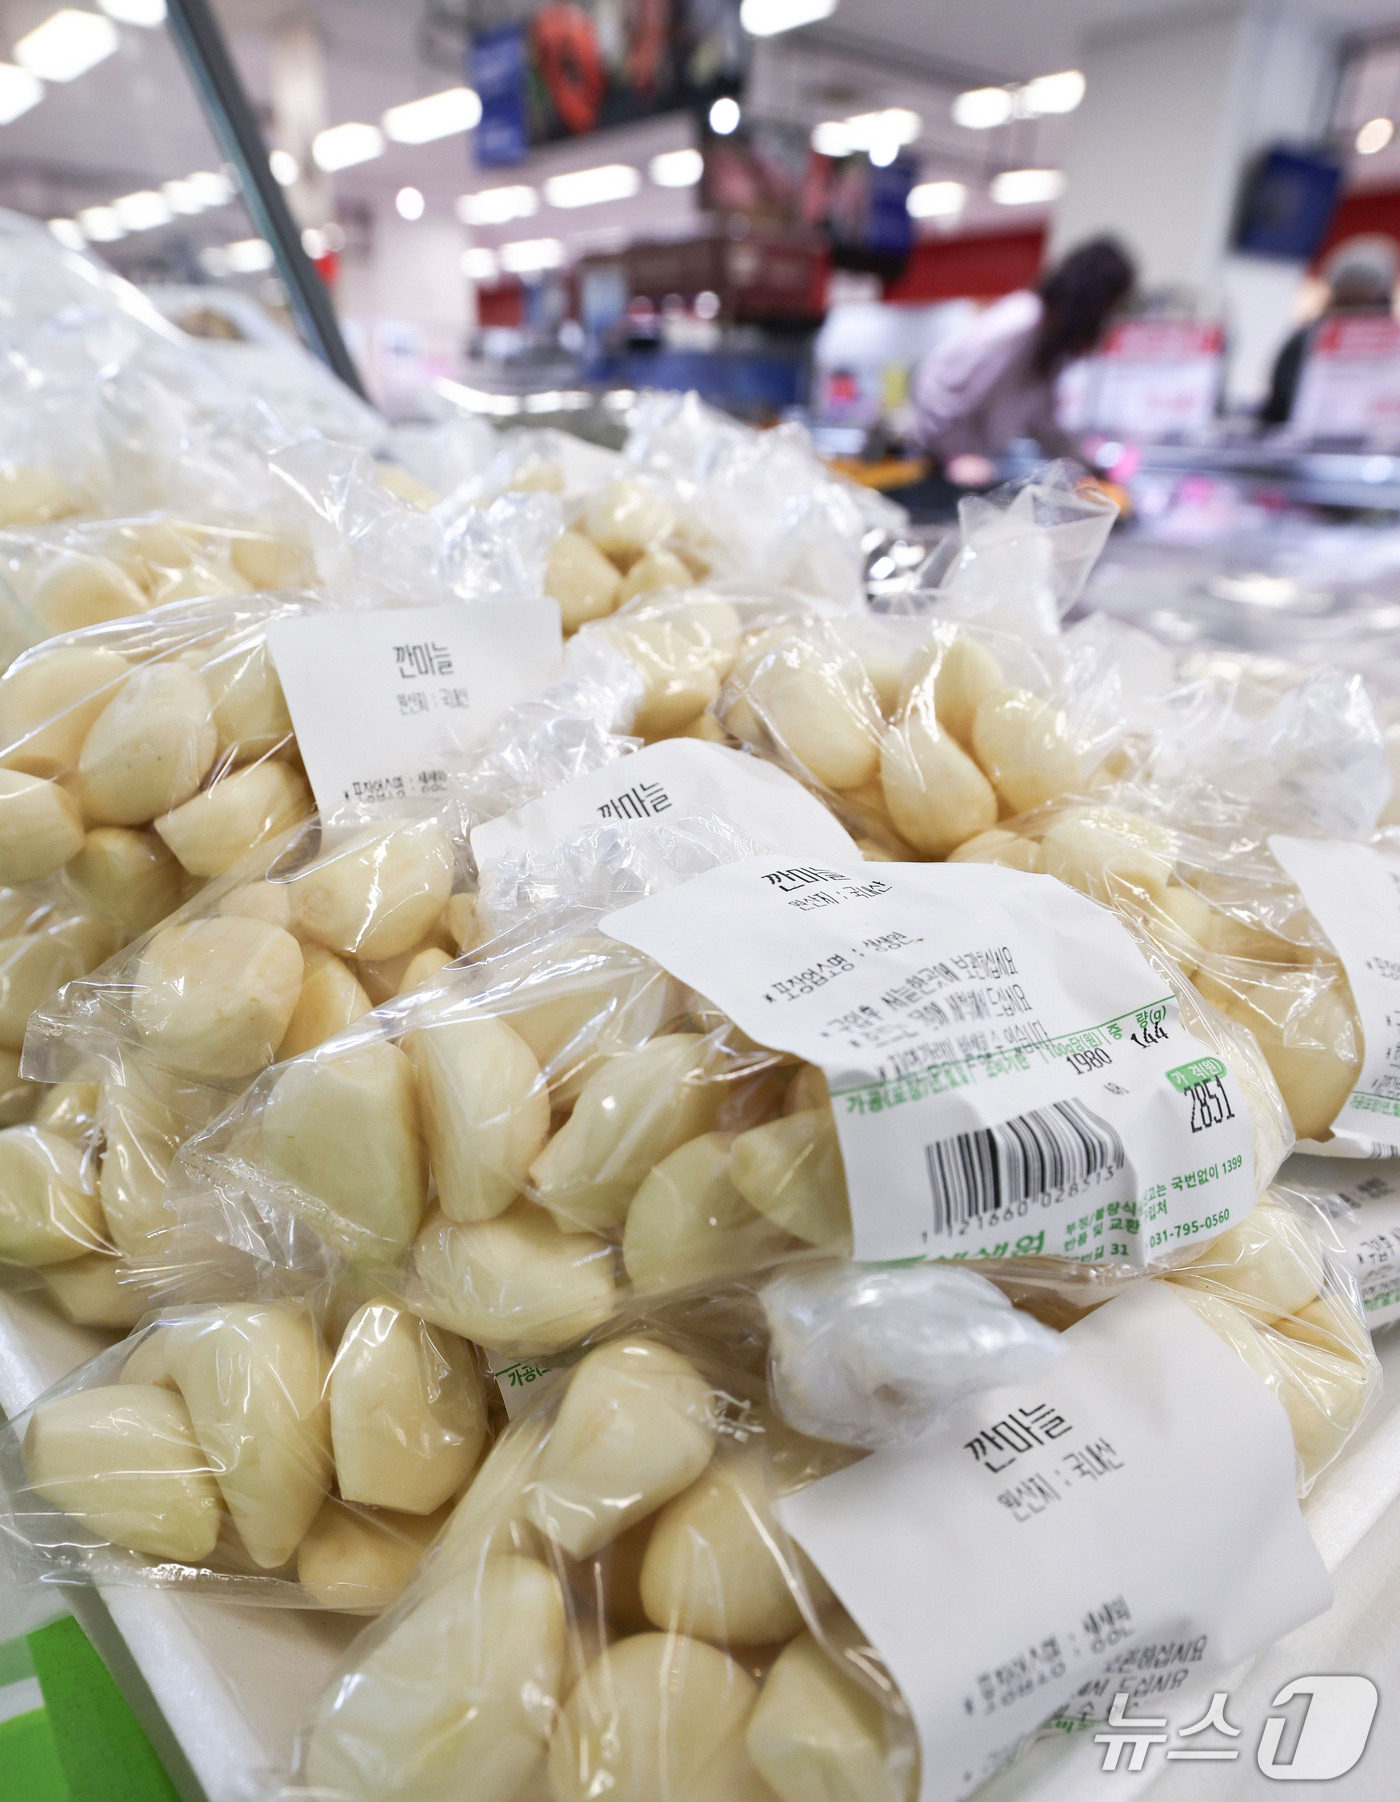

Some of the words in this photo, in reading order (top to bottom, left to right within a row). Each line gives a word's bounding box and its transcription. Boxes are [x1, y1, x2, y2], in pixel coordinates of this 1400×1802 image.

[393, 642, 454, 678] 깐마늘
[761, 866, 851, 892] 깐마늘
[788, 890, 840, 911] 원산지
[844, 880, 893, 899] 국내산
[771, 954, 855, 1002] 포장업소명
[881, 961, 962, 1012] 서늘한곳에
[1046, 1031, 1102, 1059] 100g당(원)
[1107, 1022, 1123, 1040] 중
[1135, 1005, 1167, 1029] 량(g)
[1066, 1047, 1113, 1075] 1980
[1130, 1022, 1169, 1049] 144
[1170, 1070, 1189, 1086] 가
[1184, 1074, 1236, 1133] 2851
[1171, 1163, 1219, 1191] 국번없이
[1222, 1154, 1242, 1175] 1399
[1108, 1218, 1140, 1235] 교환
[1110, 1242, 1129, 1256] 31
[1149, 1208, 1230, 1249] 031-795-0560
[963, 1403, 1073, 1473] 깐마늘
[997, 1472, 1062, 1523] 원산지
[1062, 1437, 1125, 1481] 국내산
